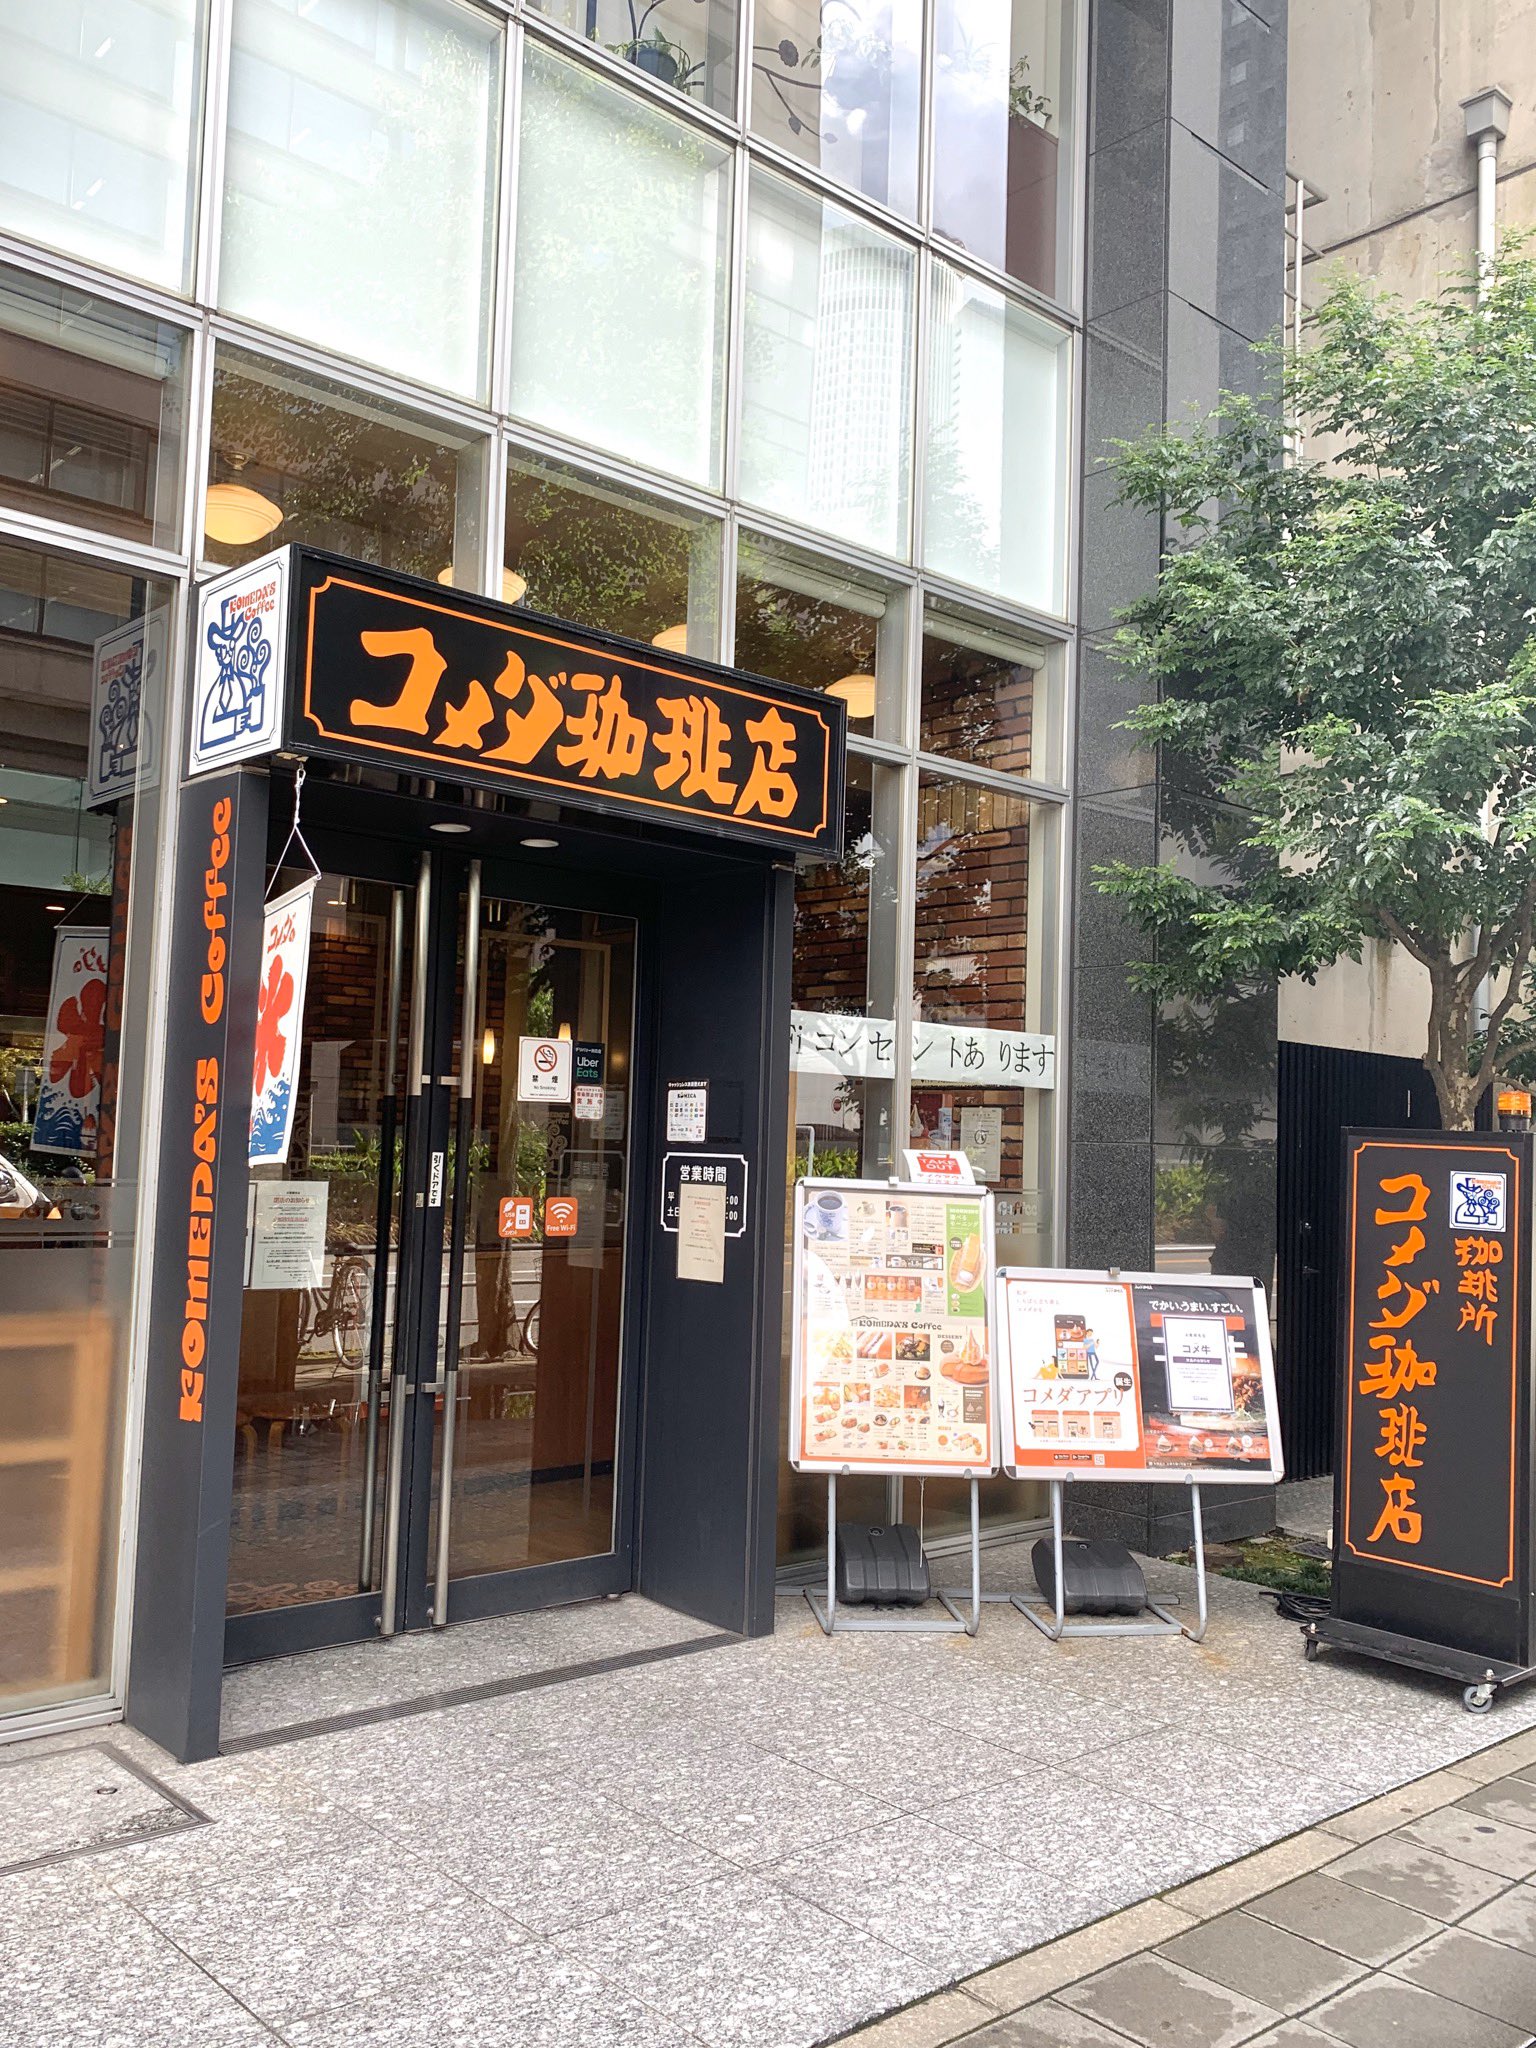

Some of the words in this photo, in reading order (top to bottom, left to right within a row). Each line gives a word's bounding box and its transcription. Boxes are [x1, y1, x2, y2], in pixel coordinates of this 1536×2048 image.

[229, 581, 276, 614] KOMEDA'S
[244, 599, 275, 621] Coffee
[350, 627, 801, 818] コメダ珈琲店
[577, 1057, 599, 1067] Uber
[576, 1068, 598, 1078] Eats
[179, 1056, 219, 1423] KOMEDA'S
[200, 797, 232, 1025] Coffee
[919, 1158, 956, 1166] TAKE
[680, 1165, 727, 1183] 営業時間
[1454, 1235, 1504, 1346] 珈琲所
[911, 1321, 942, 1331] Coffee
[1182, 1344, 1211, 1355] コメ牛
[1359, 1173, 1440, 1543] コメダ珈琲店
[1023, 1385, 1125, 1406] コメダアプリ
